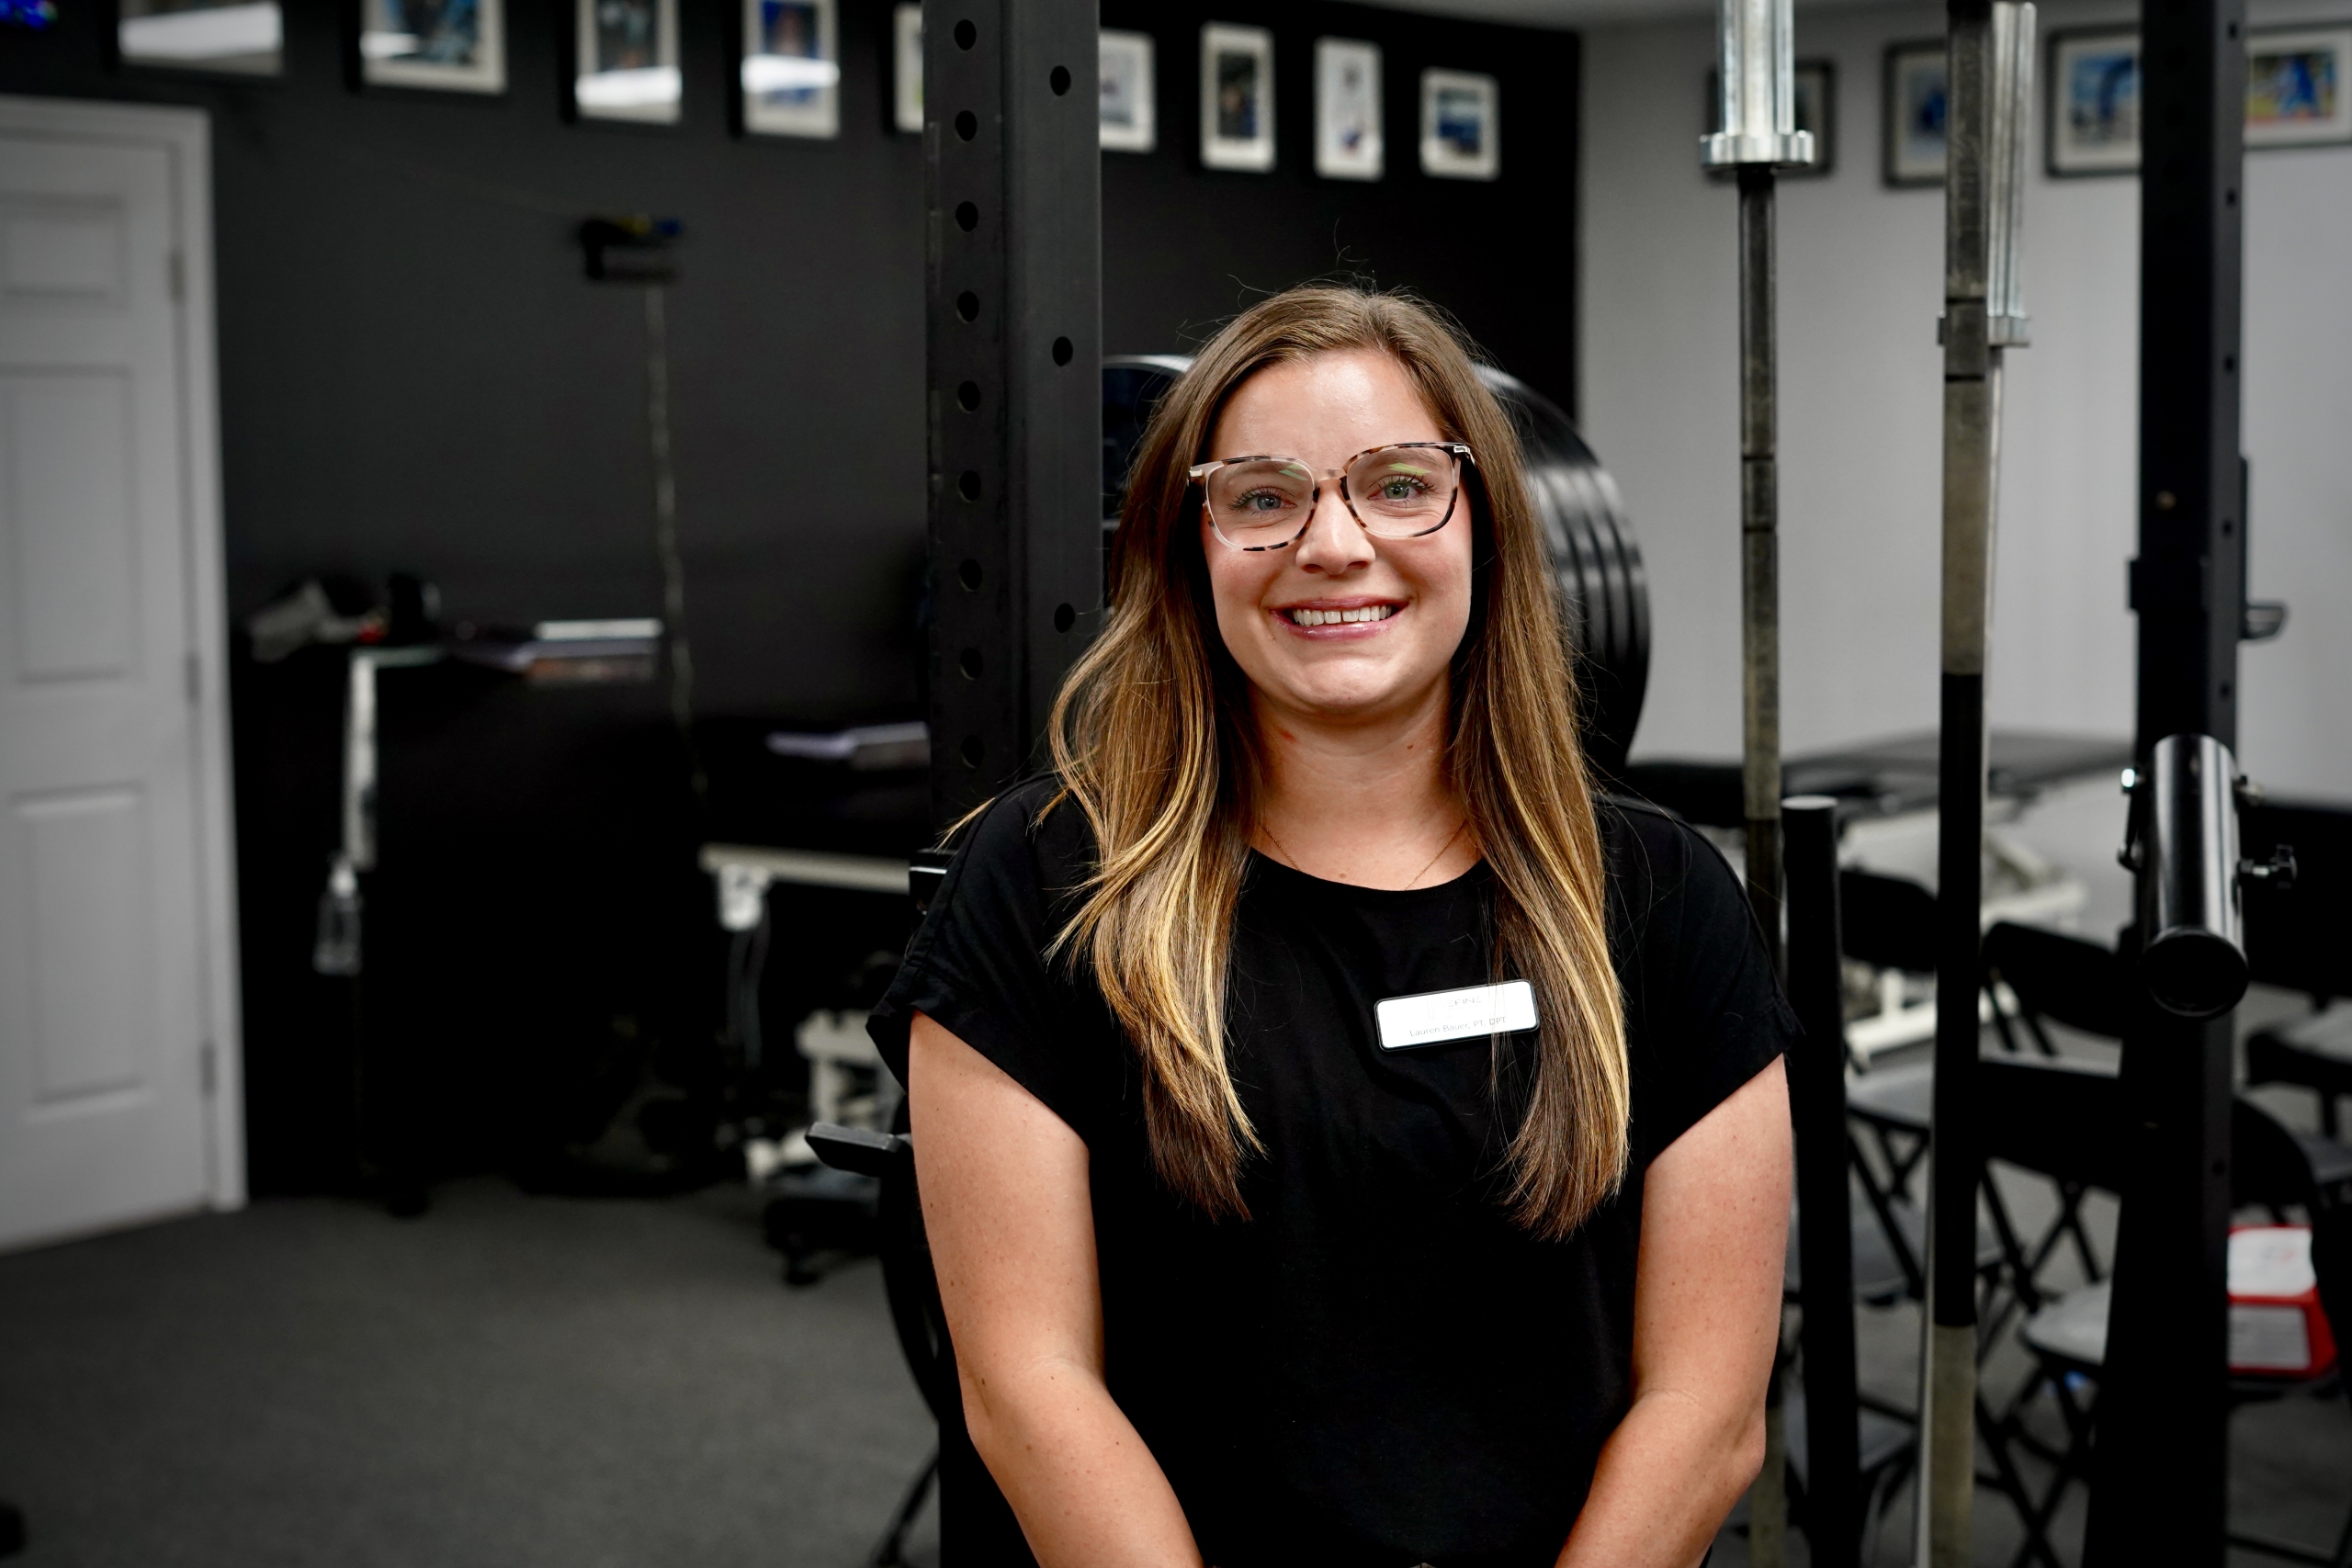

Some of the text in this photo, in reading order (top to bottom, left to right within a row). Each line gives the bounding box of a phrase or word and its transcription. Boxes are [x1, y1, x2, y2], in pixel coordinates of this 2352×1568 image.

[1409, 1016, 1507, 1037] Lauren Bauer, PT, DPT
